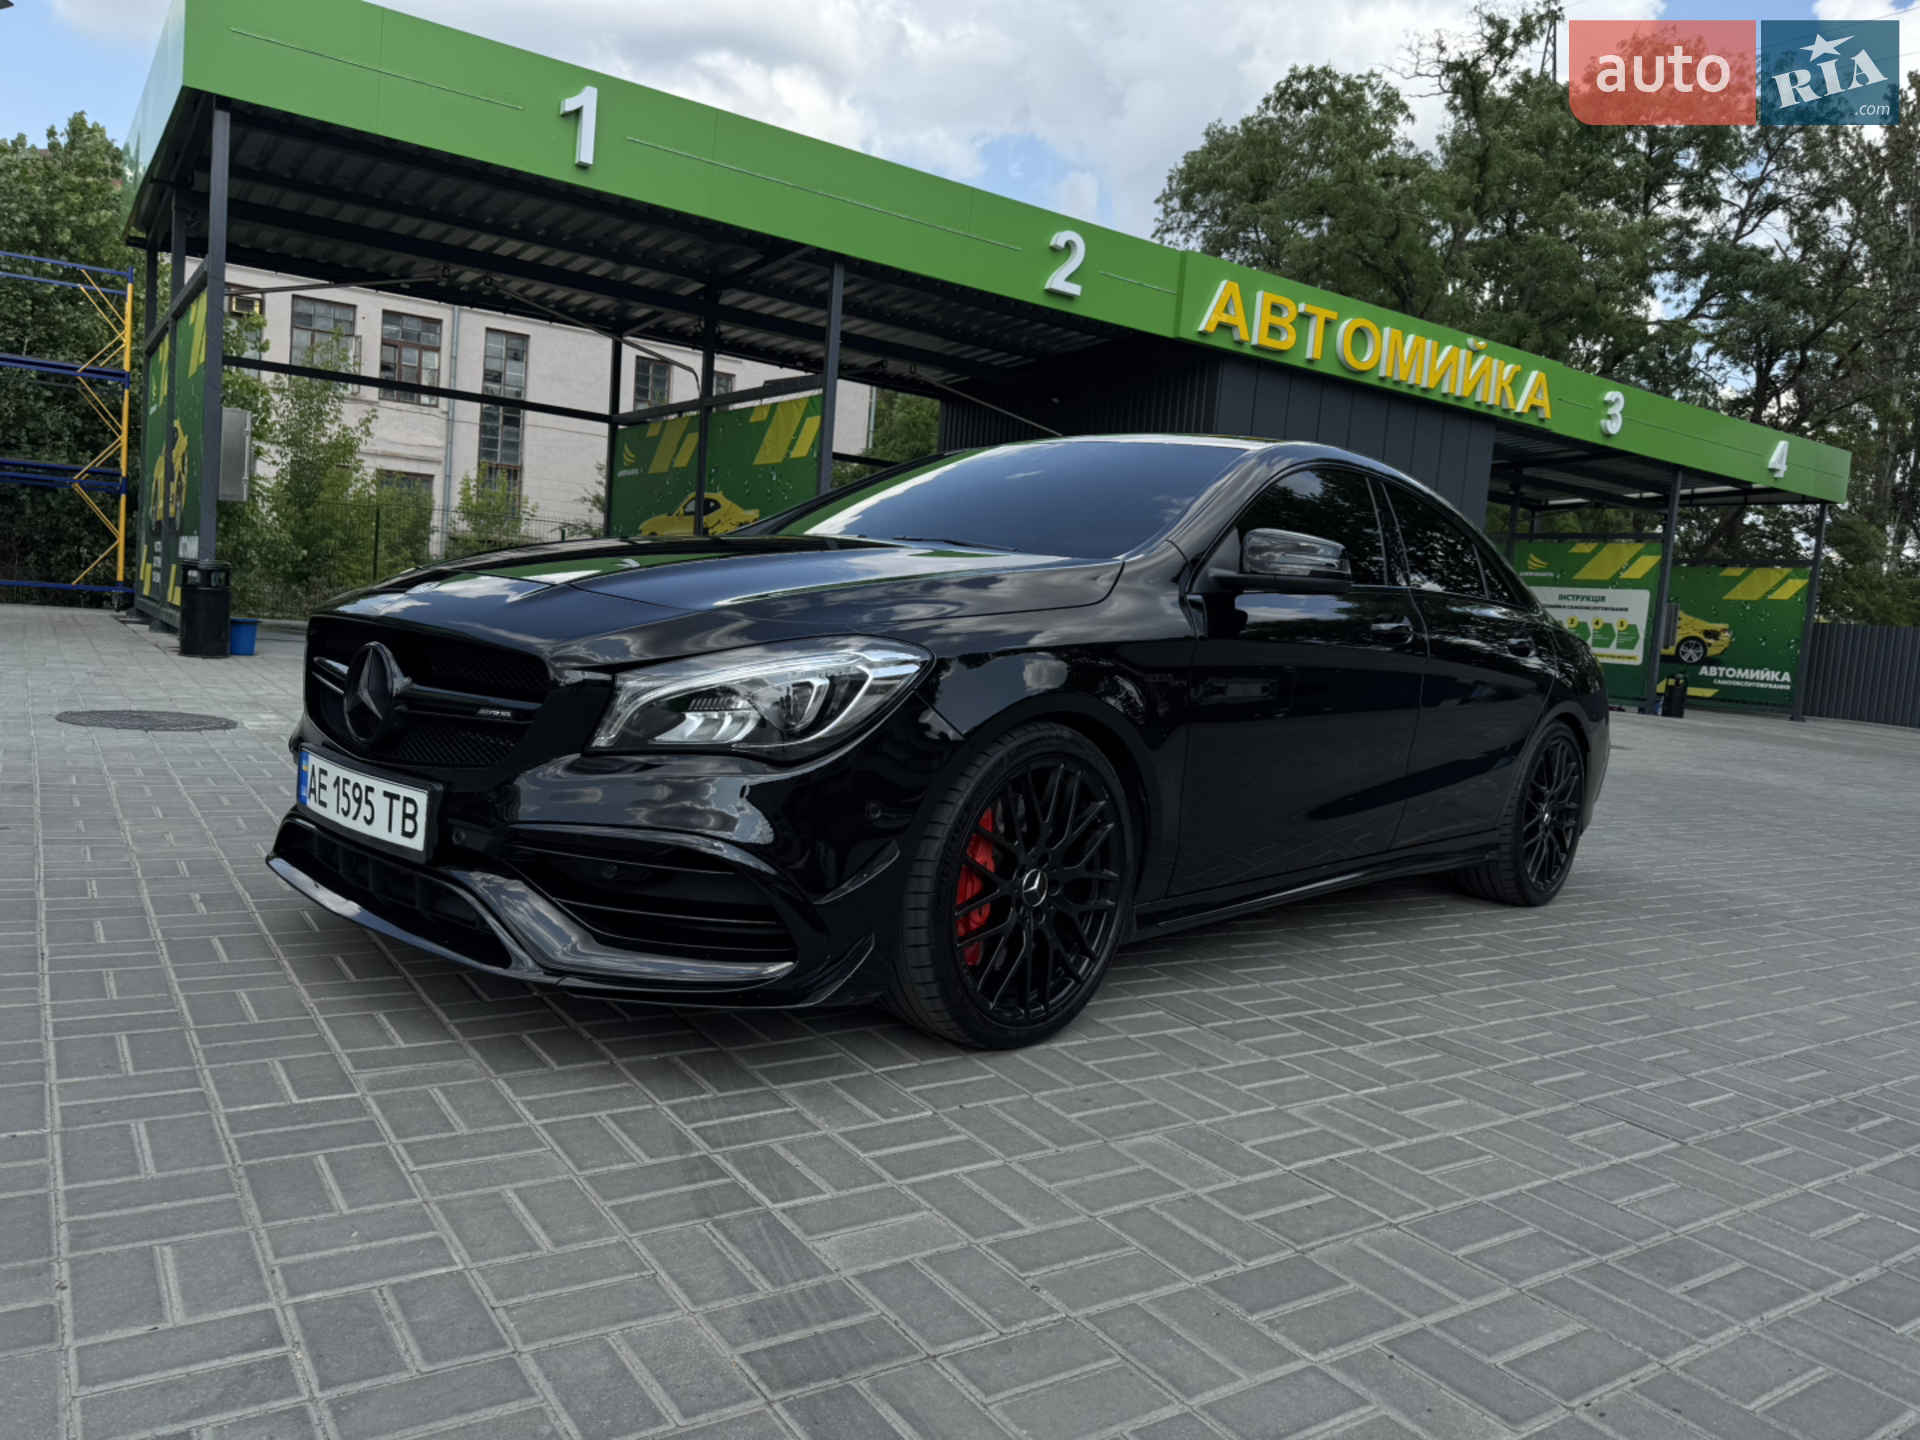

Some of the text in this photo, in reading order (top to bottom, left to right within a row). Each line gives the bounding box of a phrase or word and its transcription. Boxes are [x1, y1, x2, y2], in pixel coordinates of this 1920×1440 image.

[560, 85, 598, 168] 1
[1044, 230, 1086, 297] 2
[1197, 279, 1552, 420] АВТОМИЙКА
[1600, 390, 1625, 436] 3
[1767, 440, 1790, 478] 4
[1558, 594, 1606, 603] ІНСТРУКЦІЯ
[1698, 665, 1791, 683] АВТОМИЙКА
[308, 764, 418, 839] AE 1595 TB
